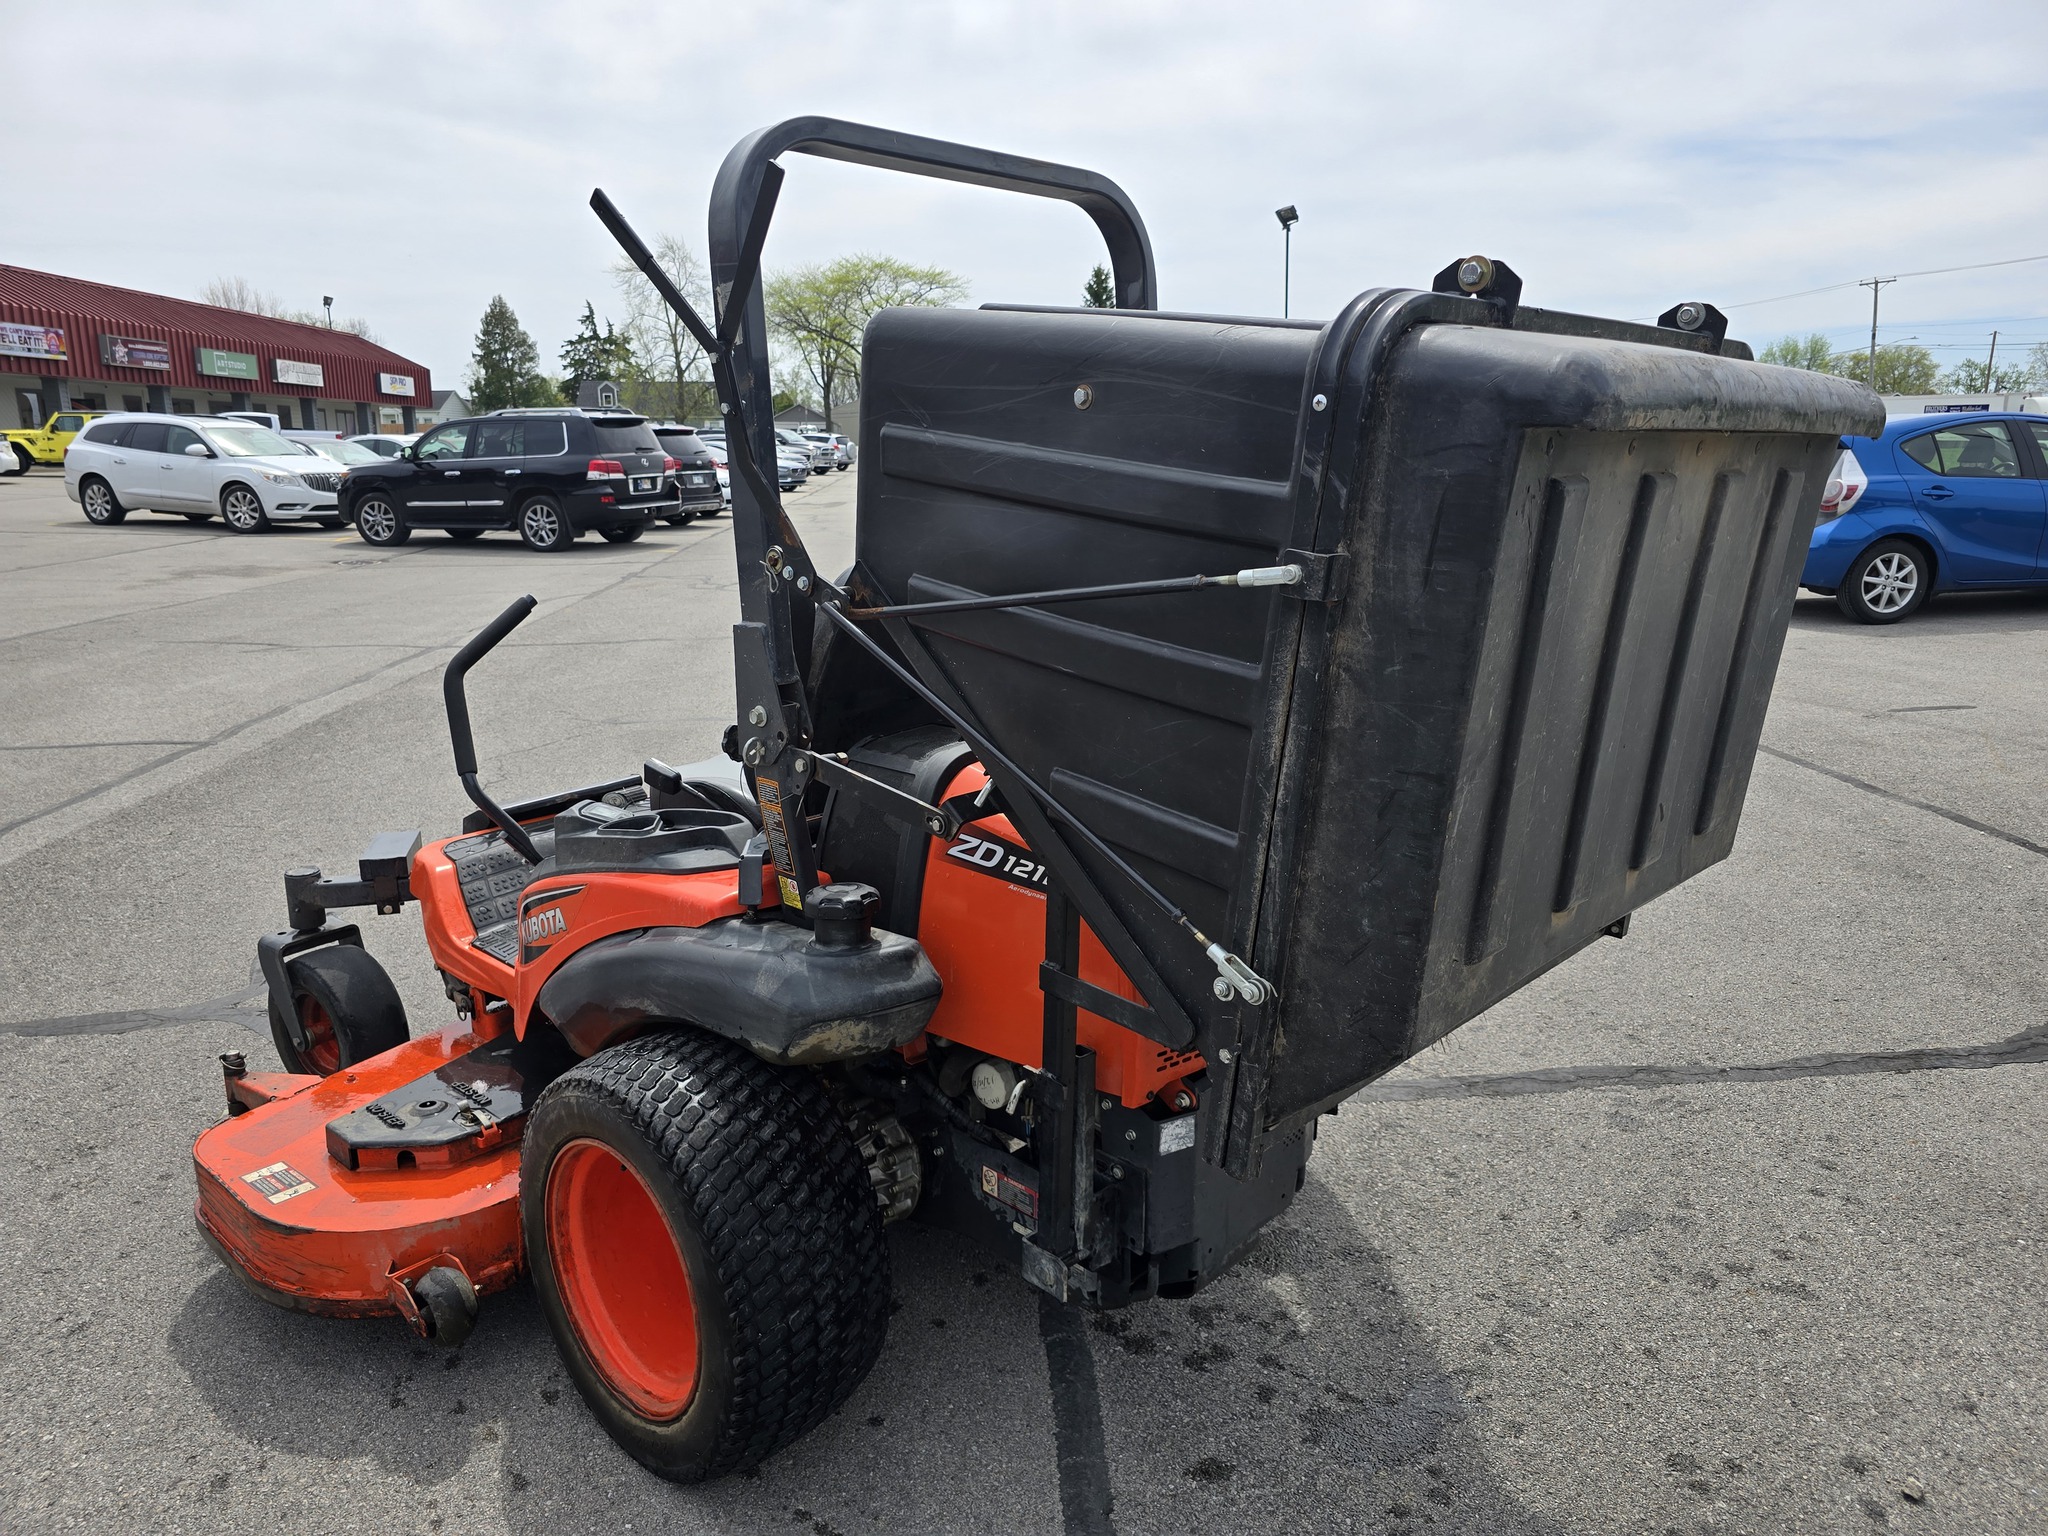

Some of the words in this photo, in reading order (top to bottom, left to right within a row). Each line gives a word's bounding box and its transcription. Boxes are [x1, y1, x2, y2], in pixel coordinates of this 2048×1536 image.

[0, 333, 17, 345] E'LL
[18, 335, 32, 347] EAT
[33, 338, 44, 348] IT!
[947, 833, 1005, 868] ZD
[521, 906, 568, 945] KUBOTA
[377, 1111, 406, 1129] STEP
